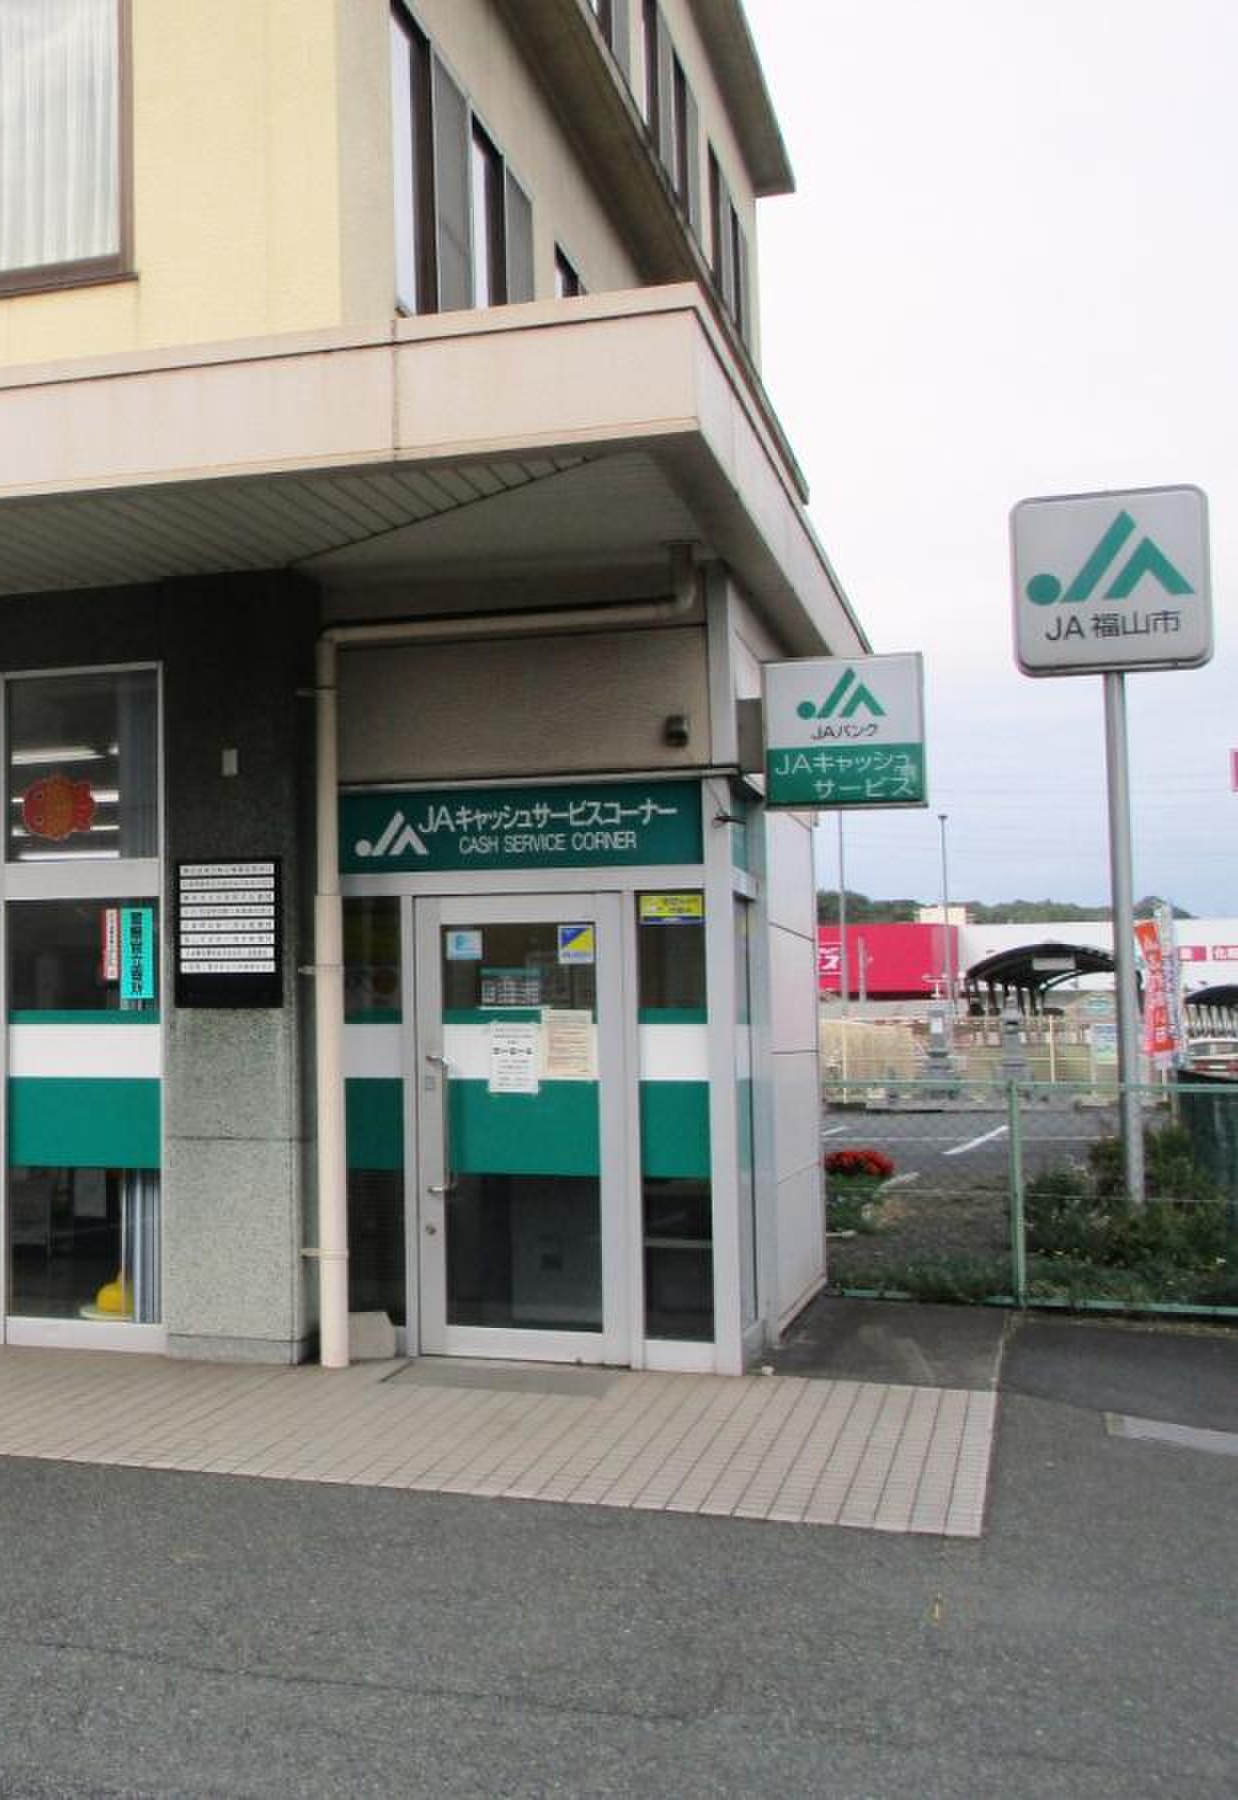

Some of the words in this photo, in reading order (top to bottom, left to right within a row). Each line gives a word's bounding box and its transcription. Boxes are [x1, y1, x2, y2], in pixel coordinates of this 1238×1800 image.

[811, 723, 879, 740] JAバンク
[775, 752, 910, 775] JAキャッシュ
[813, 777, 914, 799] サービス
[418, 797, 678, 834] JAキャッシュサービスコーナー
[459, 835, 499, 855] CASH
[505, 832, 567, 853] SERVICE
[571, 831, 637, 851] CORNER
